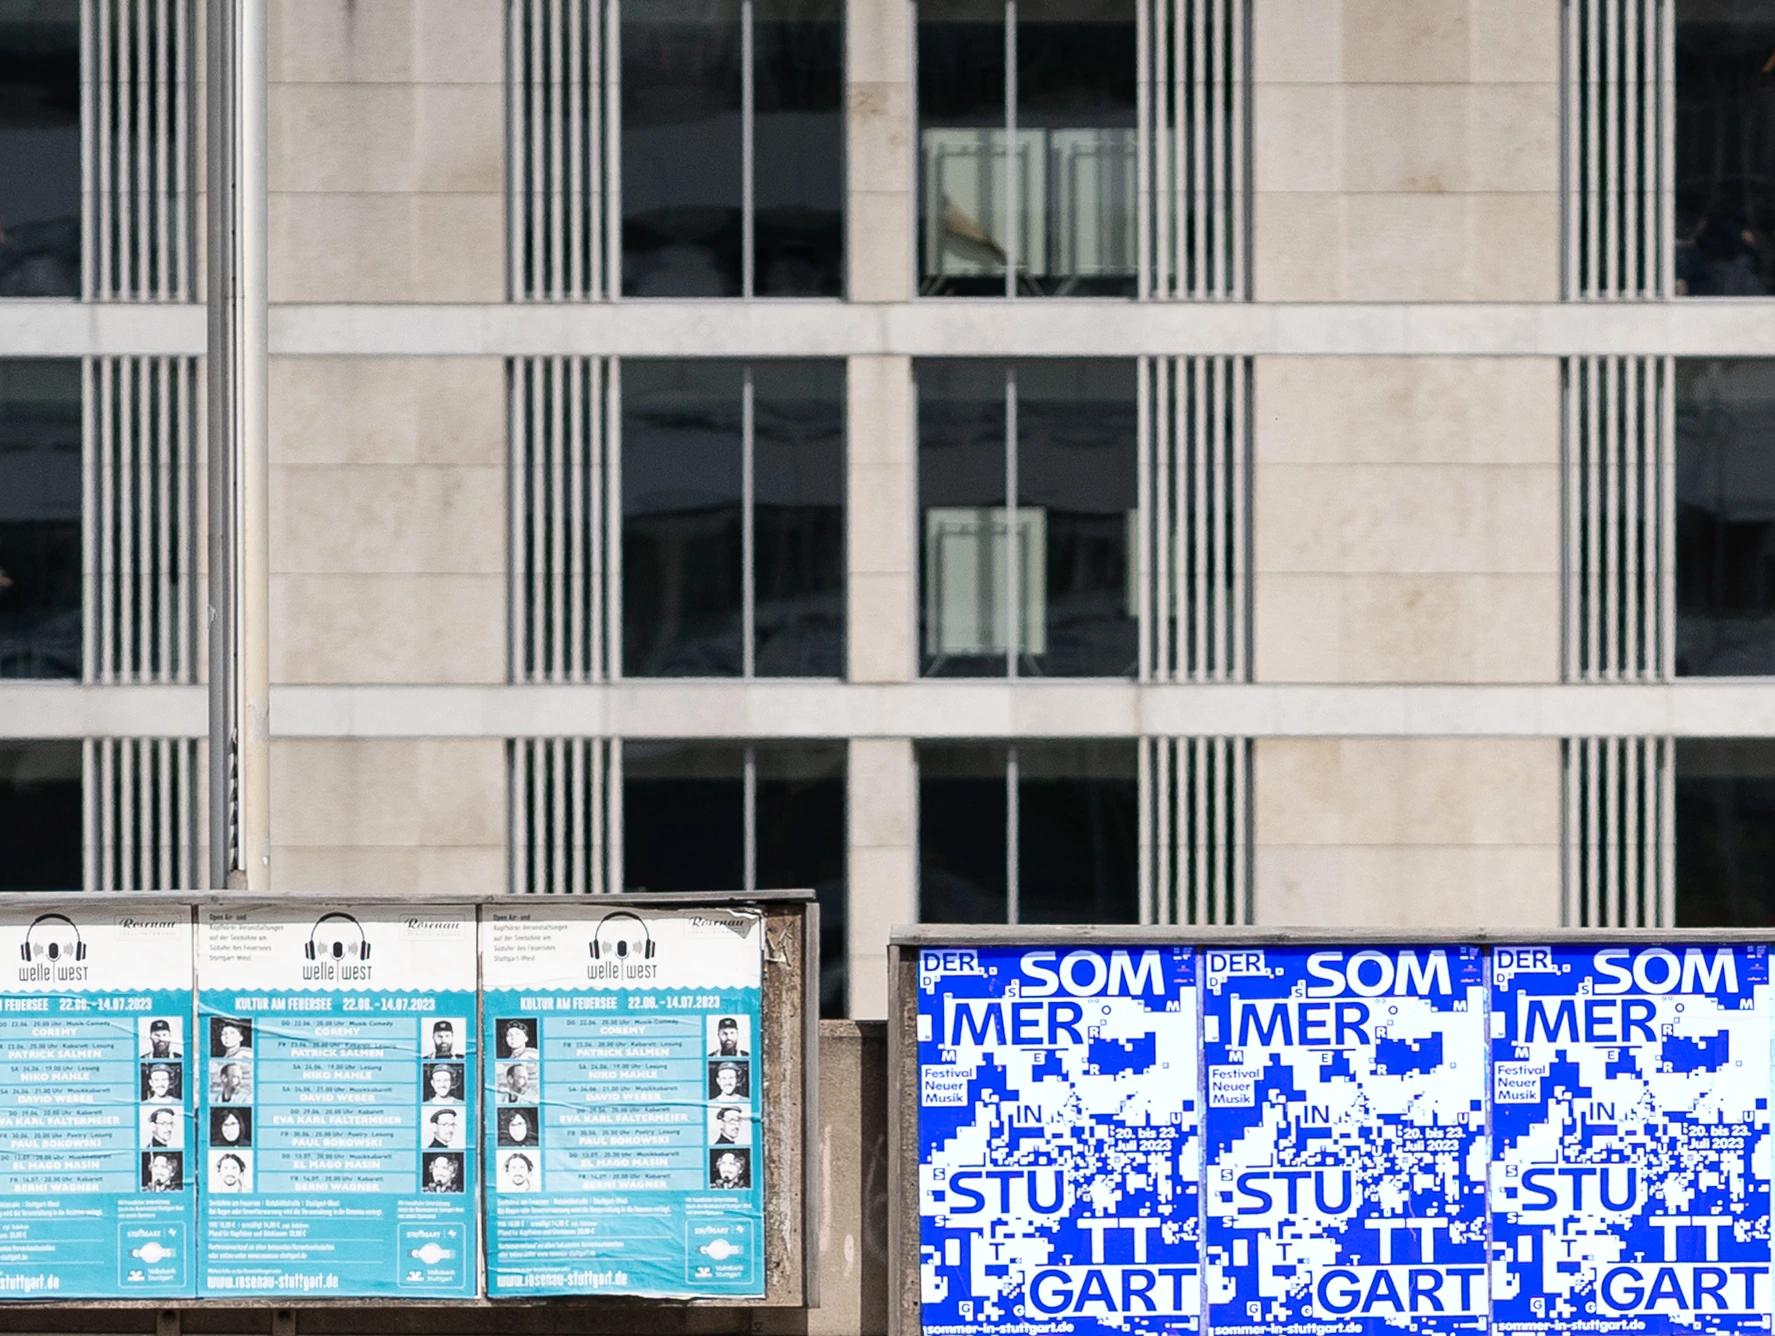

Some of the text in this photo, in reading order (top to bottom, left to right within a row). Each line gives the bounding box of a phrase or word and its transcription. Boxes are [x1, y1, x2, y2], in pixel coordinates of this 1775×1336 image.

[404, 918, 460, 929] Rosenau
[924, 953, 975, 972] DER
[1211, 953, 1262, 972] DER
[1498, 950, 1549, 968] DER
[19, 963, 89, 981] welle west
[303, 962, 372, 980] welle west
[587, 961, 657, 979] welle west
[1020, 950, 1165, 996] SOM
[1307, 951, 1452, 997] SOM
[1594, 948, 1739, 994] SOM
[5, 999, 48, 1011] FEUERSEE
[235, 998, 332, 1010] KULTUR AM FEUERSEE
[520, 997, 617, 1010] KULTUR AM FEUERSEE
[952, 1001, 1084, 1045] MER
[1239, 1001, 1371, 1045] MER
[1525, 998, 1657, 1042] MER
[925, 1068, 973, 1078] Festival
[1212, 1069, 1260, 1079] Festival
[1498, 1065, 1546, 1075] Festival
[925, 1080, 964, 1090] Neuer
[1212, 1081, 1251, 1091] Neuer
[1498, 1077, 1536, 1087] Neuer
[925, 1093, 964, 1102] Musik
[1212, 1094, 1251, 1103] Musik
[1498, 1090, 1536, 1099] Musik
[1017, 1105, 1042, 1124] IN
[1304, 1105, 1329, 1124] IN
[1590, 1102, 1614, 1121] IN
[1116, 1128, 1178, 1138] 20. bis 23.
[1403, 1127, 1466, 1138] 20. bis 23.
[1688, 1126, 1751, 1136] 20. bis 23.
[1115, 1140, 1172, 1150] Juli 2023
[1402, 1140, 1459, 1150] Juli 2023
[1688, 1138, 1744, 1148] Juli 2023
[948, 1170, 1064, 1214] STU
[1236, 1170, 1352, 1214] STU
[1521, 1167, 1637, 1211] STU
[1077, 1218, 1160, 1264] TT
[1365, 1218, 1448, 1264] TT
[1649, 1216, 1733, 1261] TT
[208, 1273, 338, 1291] www.rosenau-stuttgart.de
[1030, 1268, 1198, 1314] GART
[1317, 1268, 1485, 1314] GART
[1601, 1266, 1769, 1312] GART
[928, 1322, 1074, 1335] sommer-in-stuttgart.de
[1215, 1322, 1362, 1335] sommer-in-stuttgart.de
[1499, 1319, 1646, 1332] sommer-in-stuttgart.de
